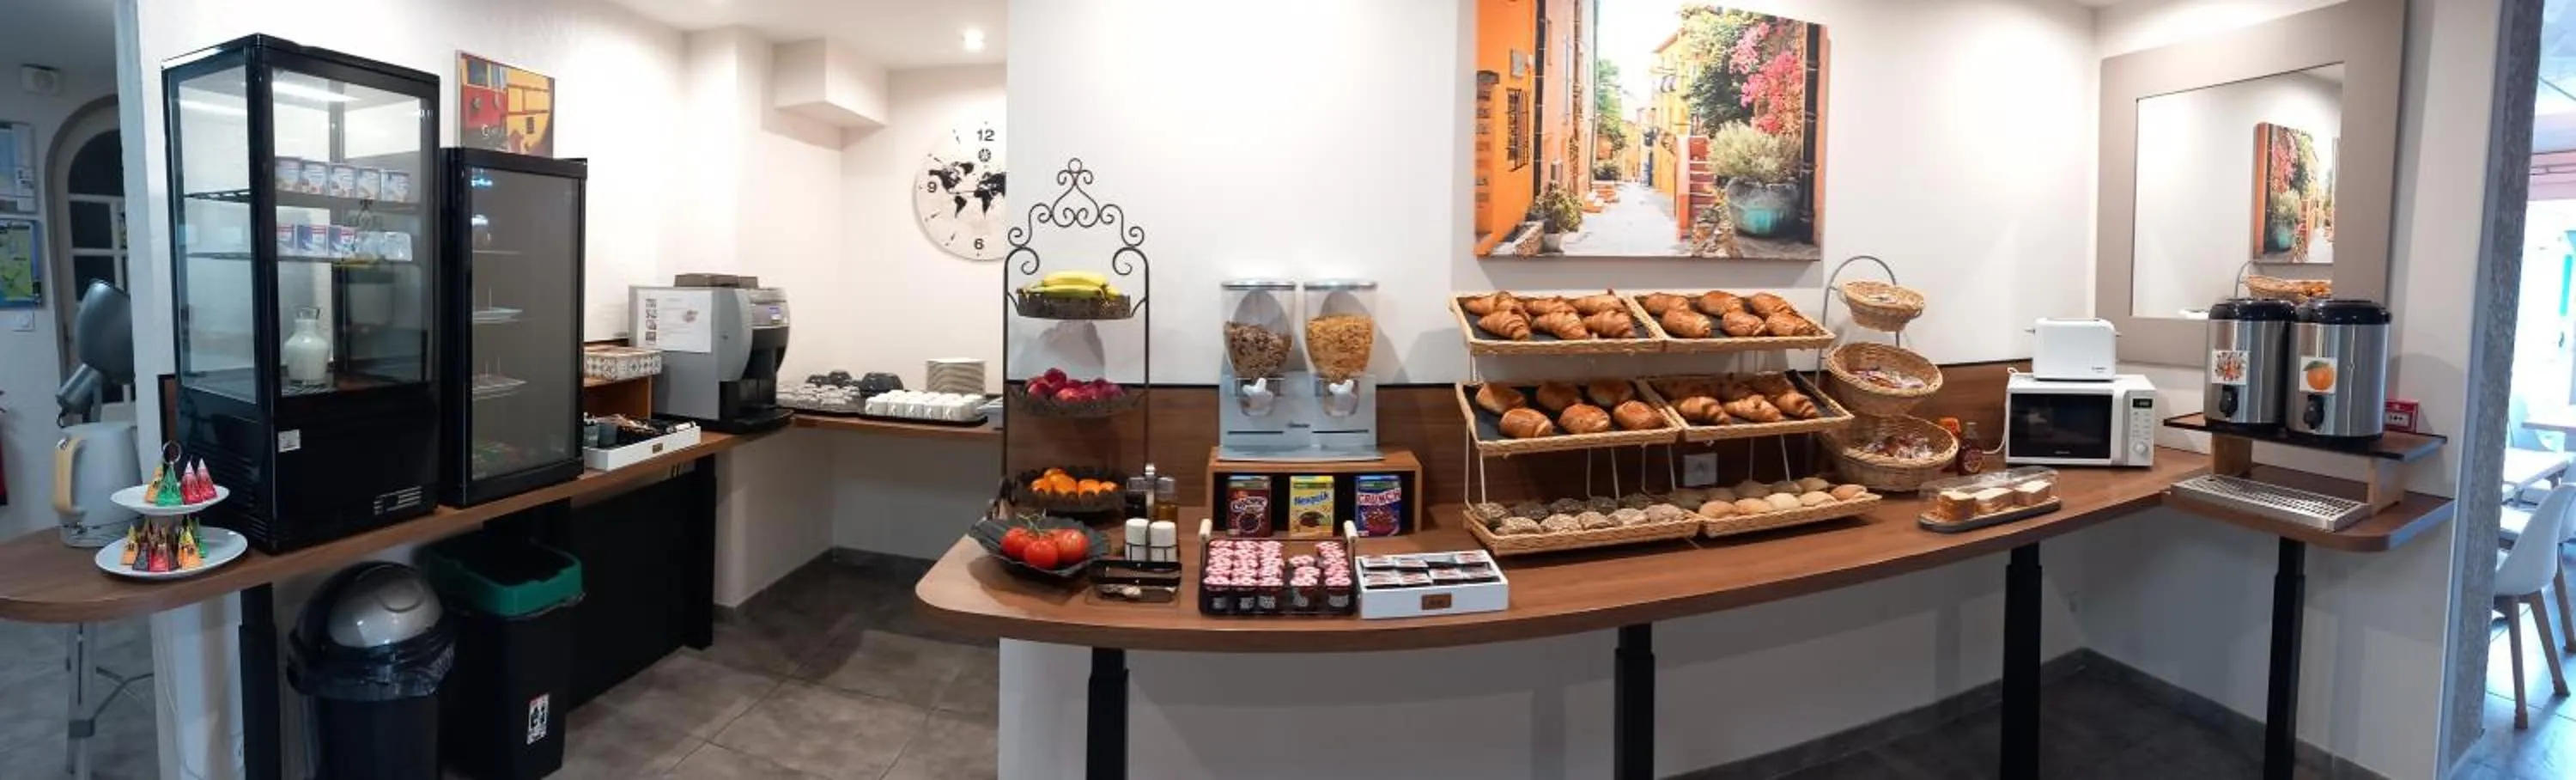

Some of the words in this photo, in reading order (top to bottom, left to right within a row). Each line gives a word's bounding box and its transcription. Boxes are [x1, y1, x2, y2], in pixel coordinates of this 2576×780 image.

[977, 129, 994, 141] 12
[927, 181, 937, 193] 9
[974, 238, 984, 250] 6
